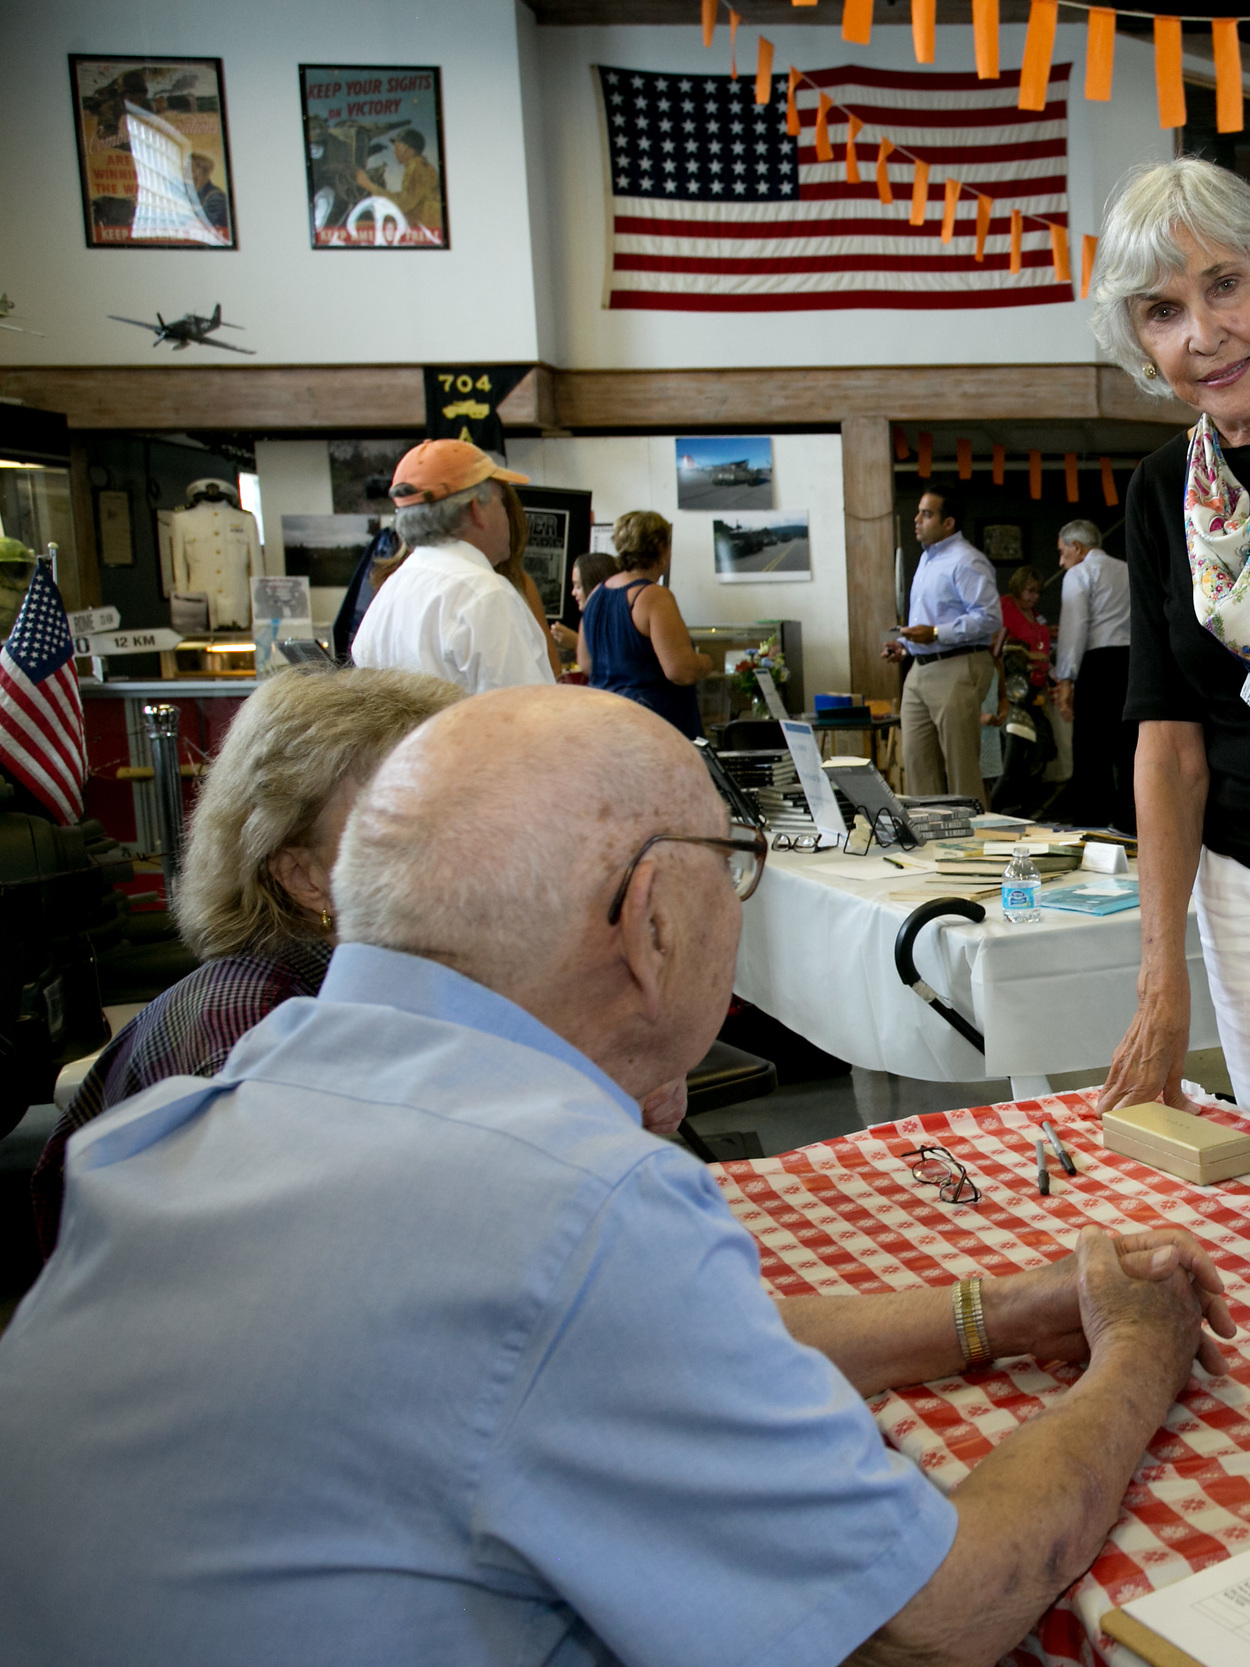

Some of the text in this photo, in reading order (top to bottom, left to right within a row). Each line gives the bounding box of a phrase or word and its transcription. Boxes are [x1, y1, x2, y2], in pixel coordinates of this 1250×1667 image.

[307, 74, 433, 99] KEEP YOUR SIGHTS
[347, 98, 402, 116] VICTORY
[93, 169, 138, 180] WINNI
[95, 184, 118, 194] THE
[101, 229, 128, 241] KEEP
[437, 374, 492, 393] 704
[114, 637, 127, 648] 12
[133, 635, 155, 646] KM
